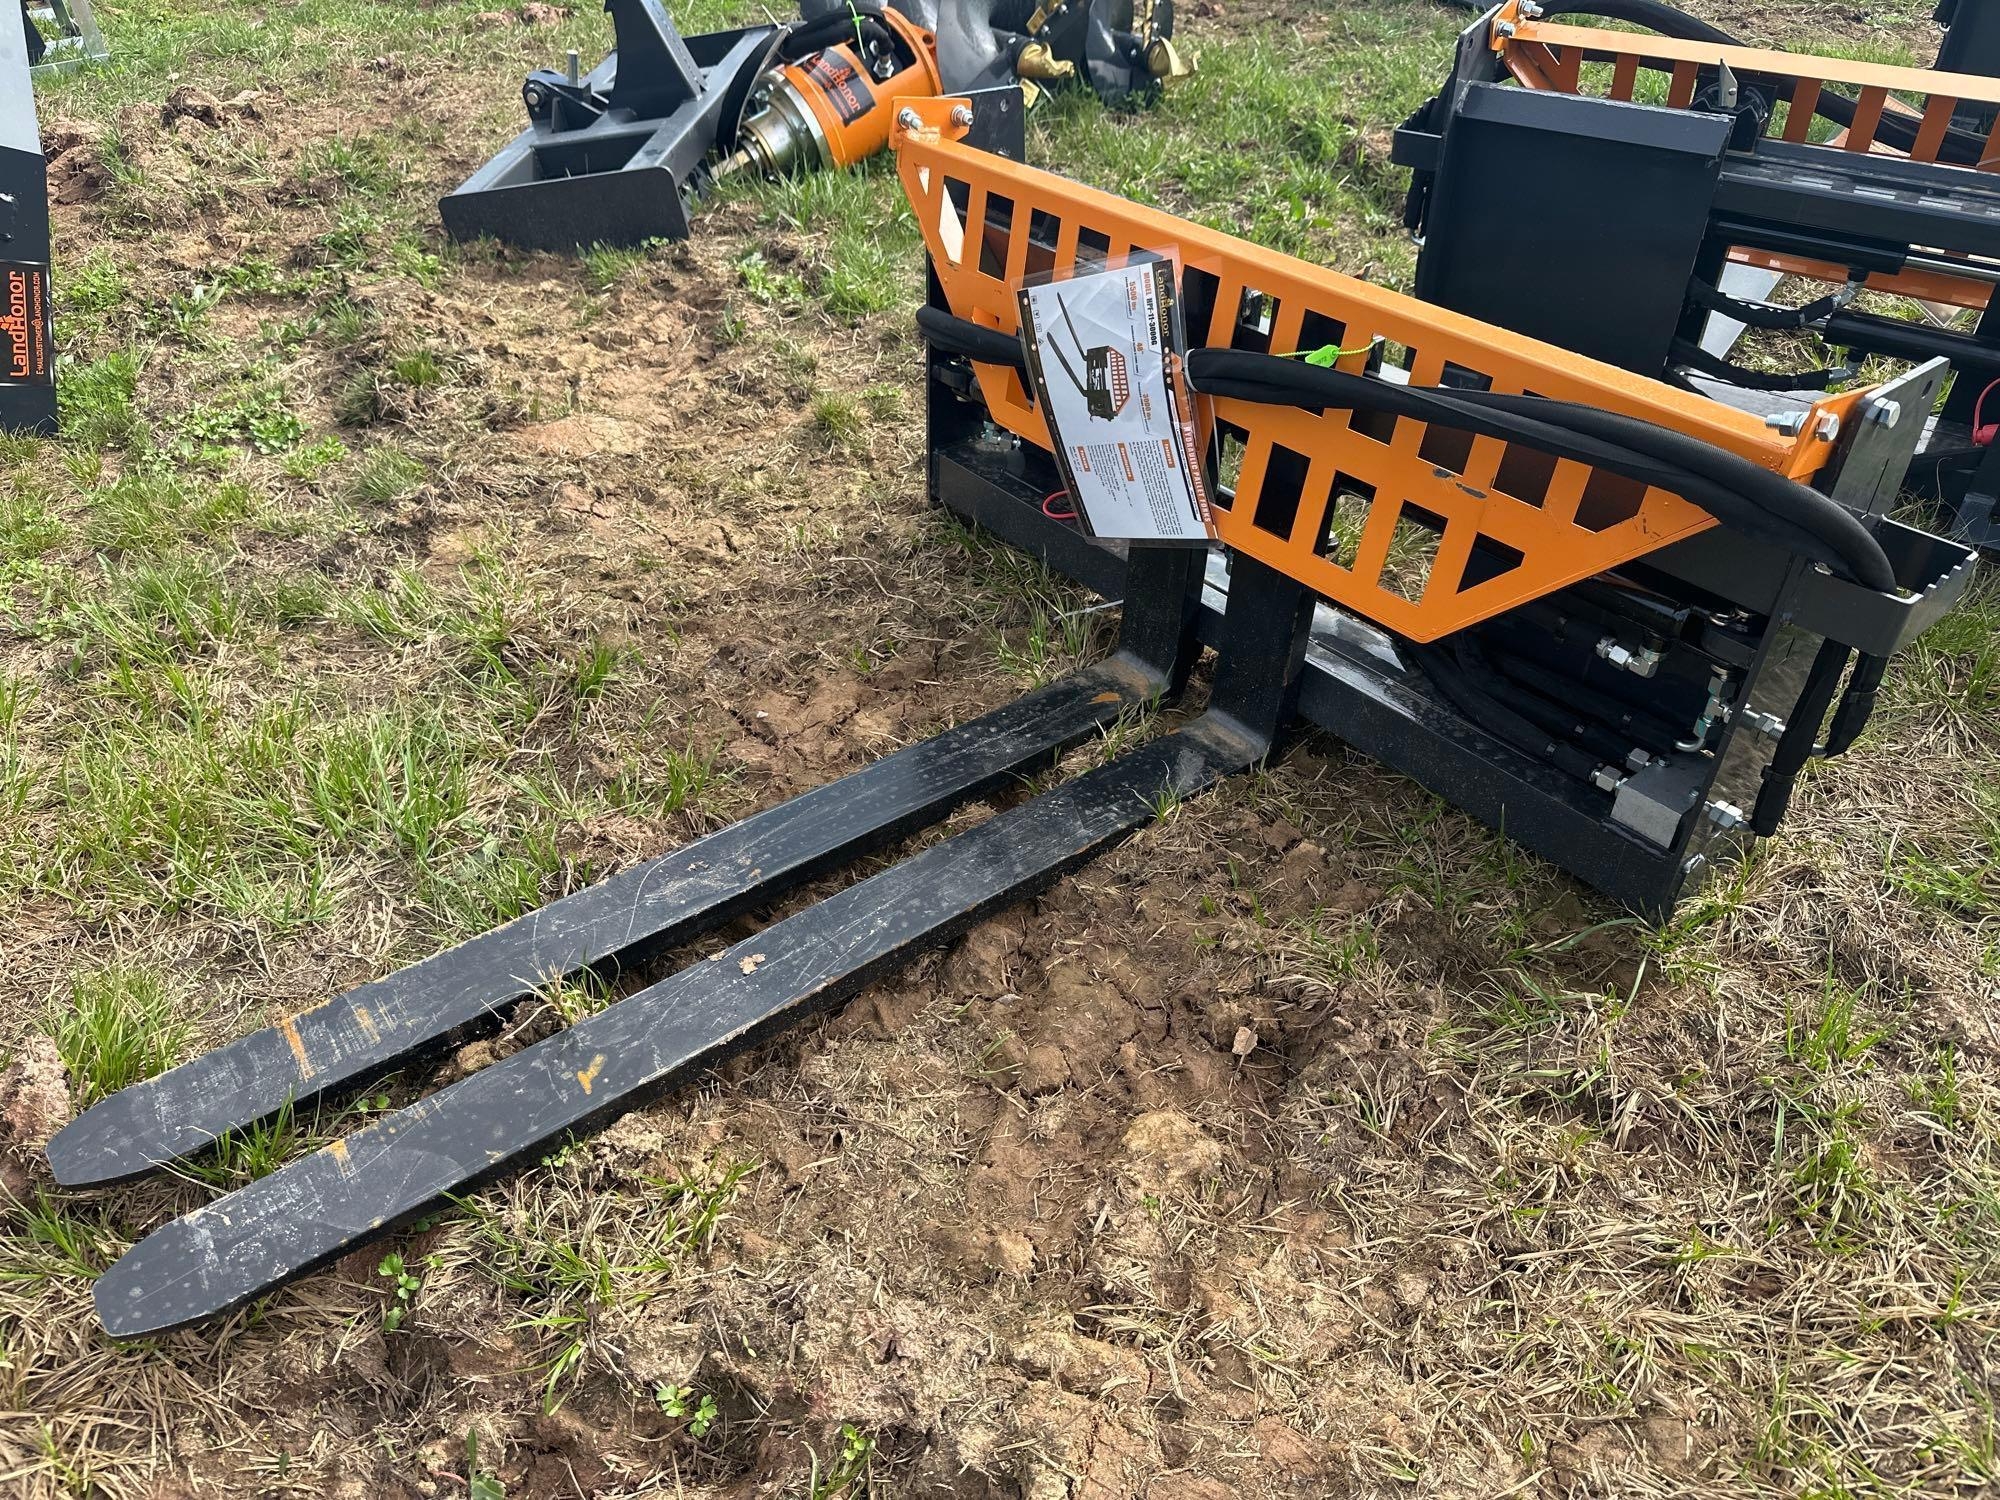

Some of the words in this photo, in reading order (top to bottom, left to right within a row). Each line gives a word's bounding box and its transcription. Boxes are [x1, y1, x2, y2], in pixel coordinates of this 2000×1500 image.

[812, 54, 860, 112] LandHonor
[1143, 272, 1152, 296] MODEL
[1156, 269, 1170, 337] LandHonor
[8, 270, 28, 376] LandHonor
[1183, 425, 1197, 470] HYDRAULIC
[1192, 470, 1206, 498] PALLET
